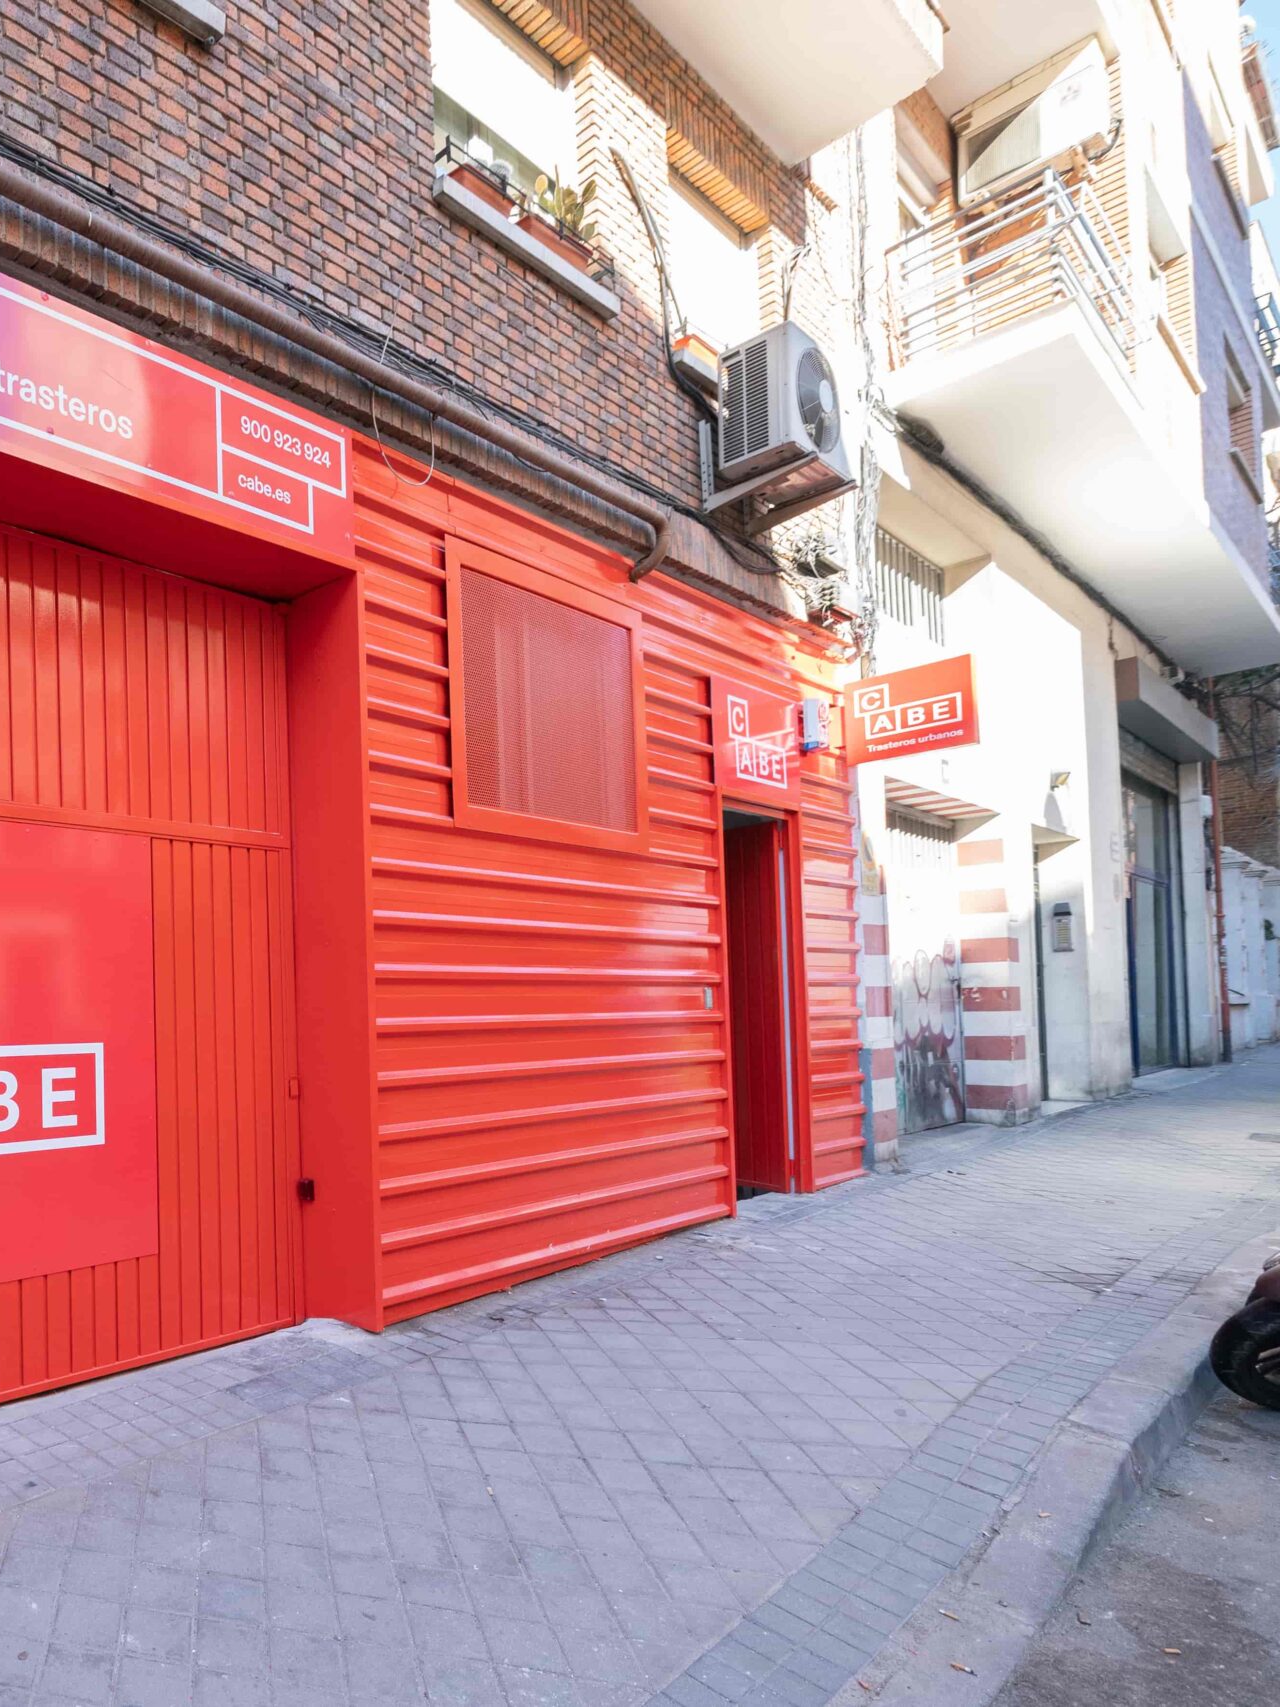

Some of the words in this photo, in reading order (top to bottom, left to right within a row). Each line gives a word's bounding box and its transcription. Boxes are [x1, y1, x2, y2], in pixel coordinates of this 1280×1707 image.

[240, 415, 272, 443] 900
[273, 430, 302, 456] 923
[303, 442, 332, 469] 924
[237, 474, 292, 505] cabe.es
[866, 738, 917, 753] Trasteros
[917, 729, 964, 744] urbanos
